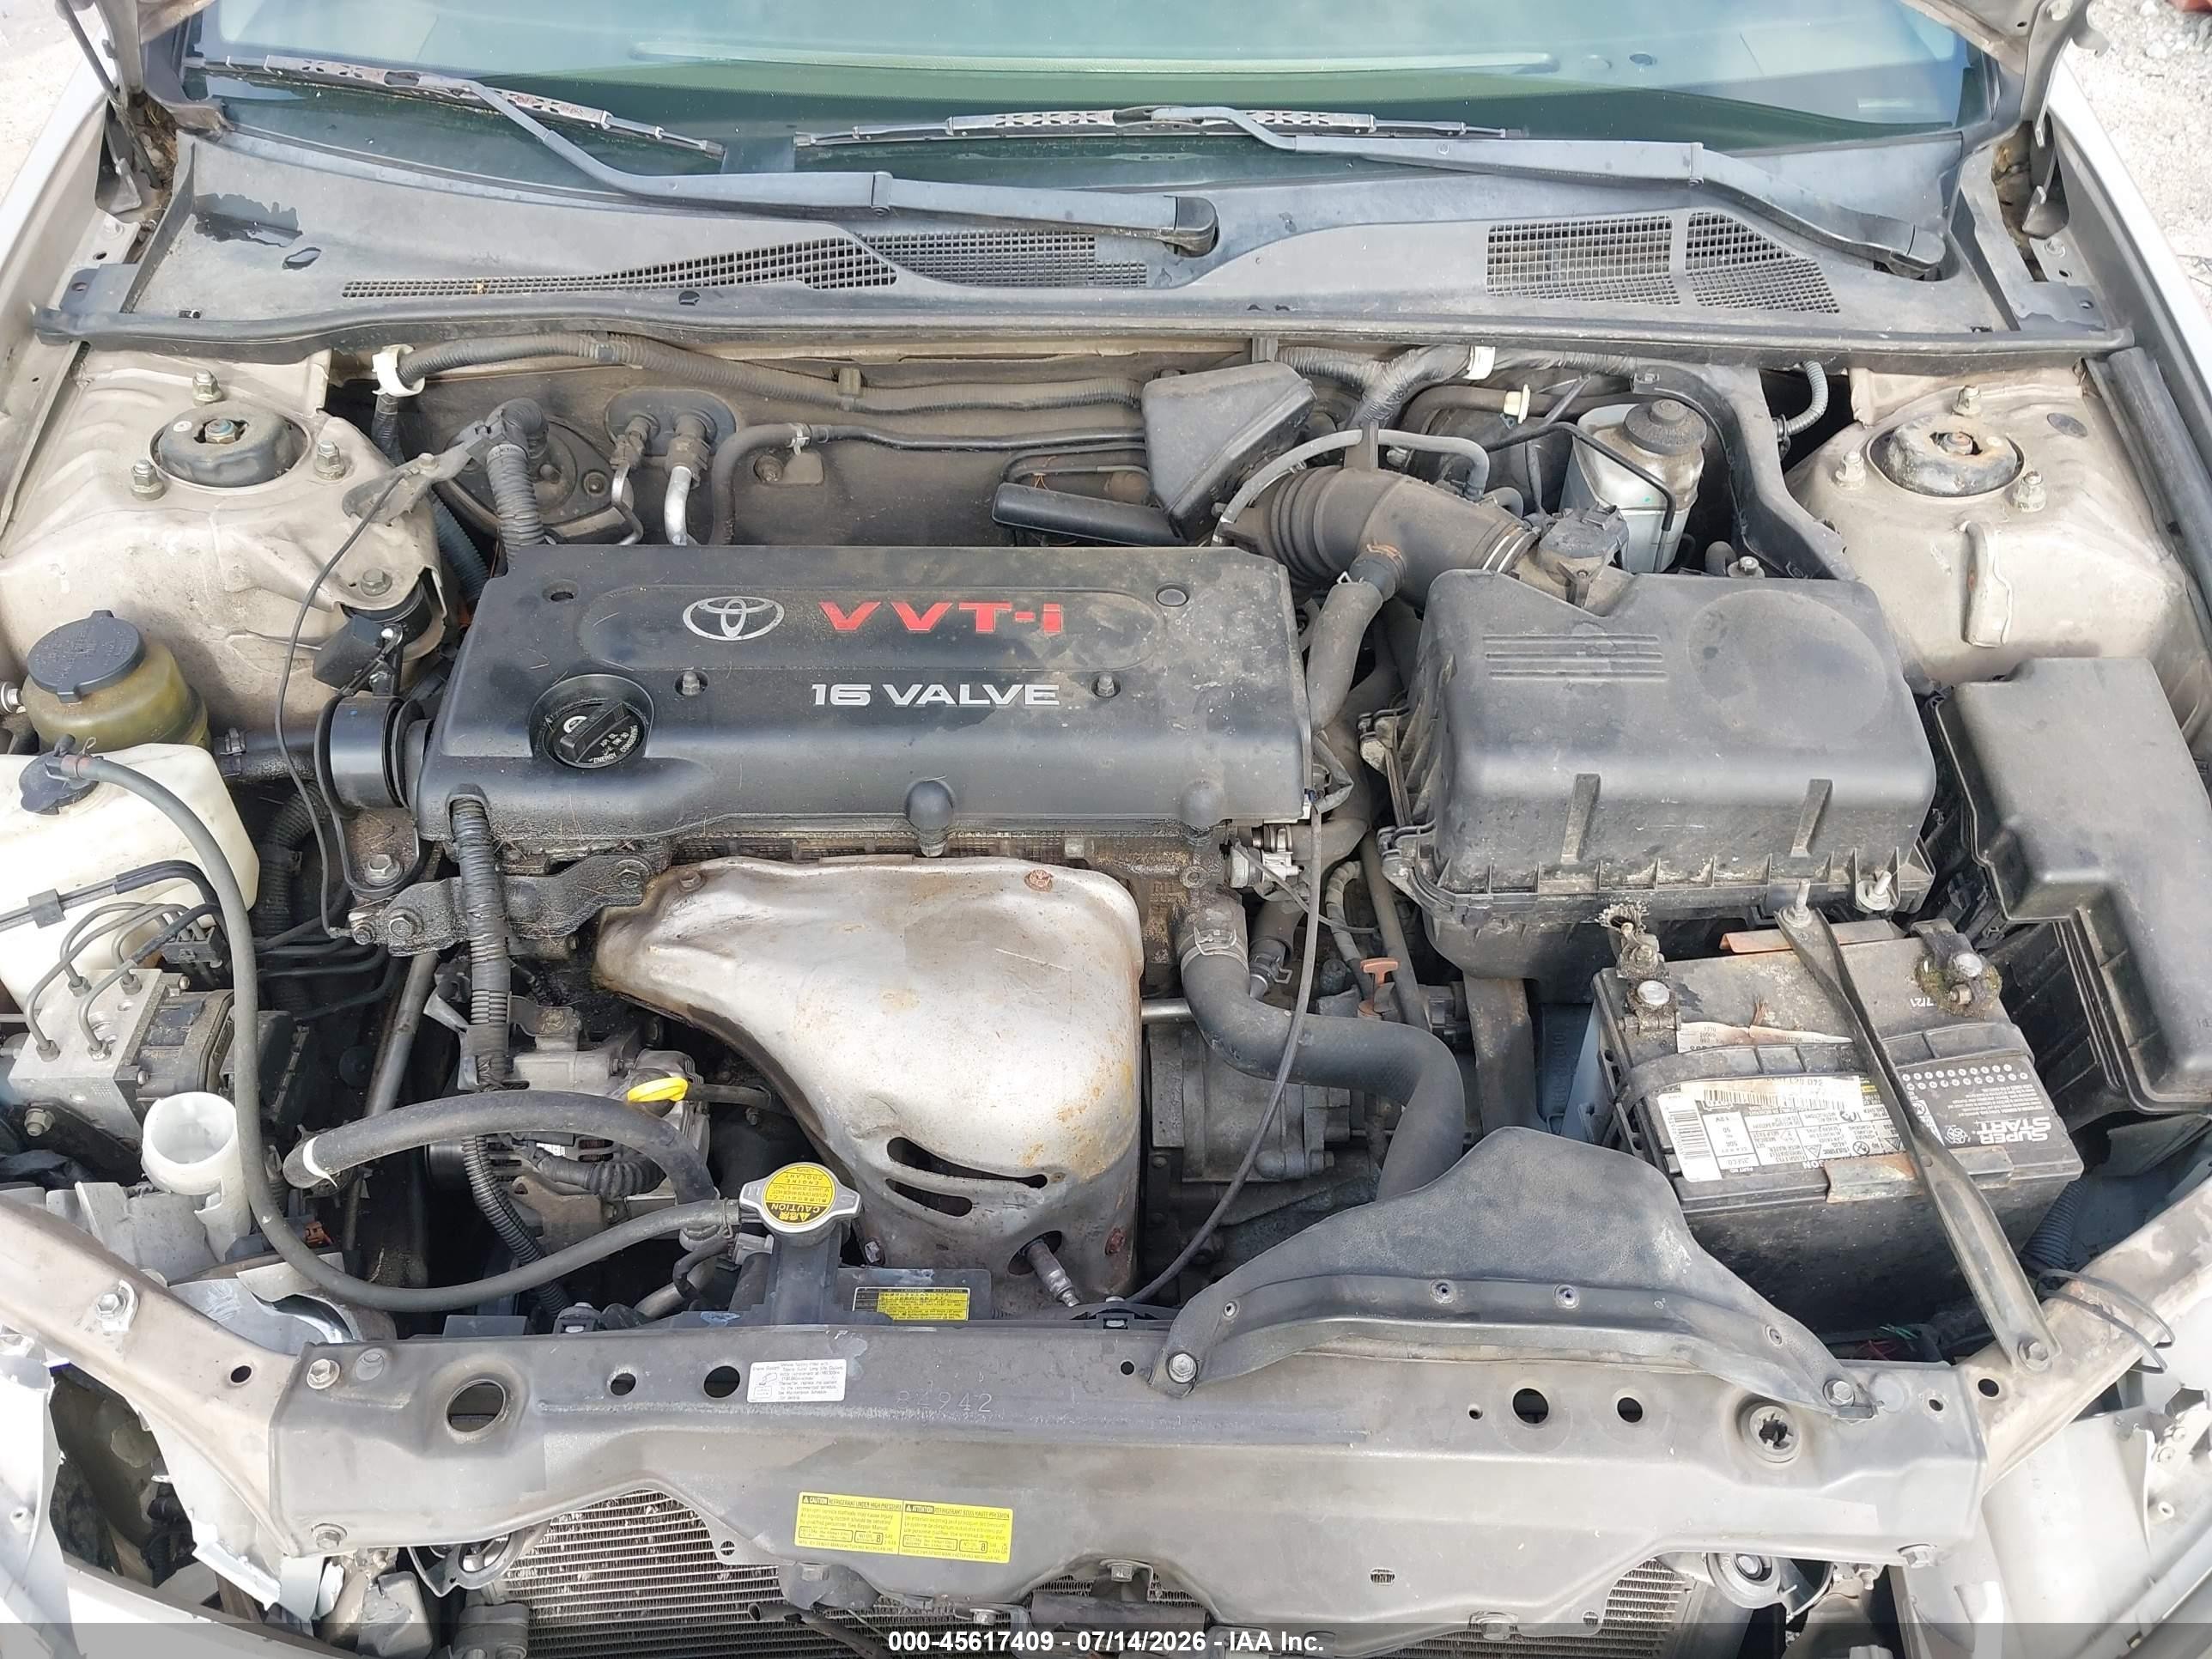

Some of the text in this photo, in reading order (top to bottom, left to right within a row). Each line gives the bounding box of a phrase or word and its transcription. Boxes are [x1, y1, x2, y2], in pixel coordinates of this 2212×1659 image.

[811, 684, 1060, 707] 16 VALVE
[619, 725, 638, 753] CONSERVING
[1978, 1116, 2052, 1134] START
[1979, 1130, 2049, 1145] SUPER
[770, 1203, 821, 1213] CAUTION
[809, 1497, 827, 1505] CAUTION
[912, 1505, 933, 1514] ATTENTION
